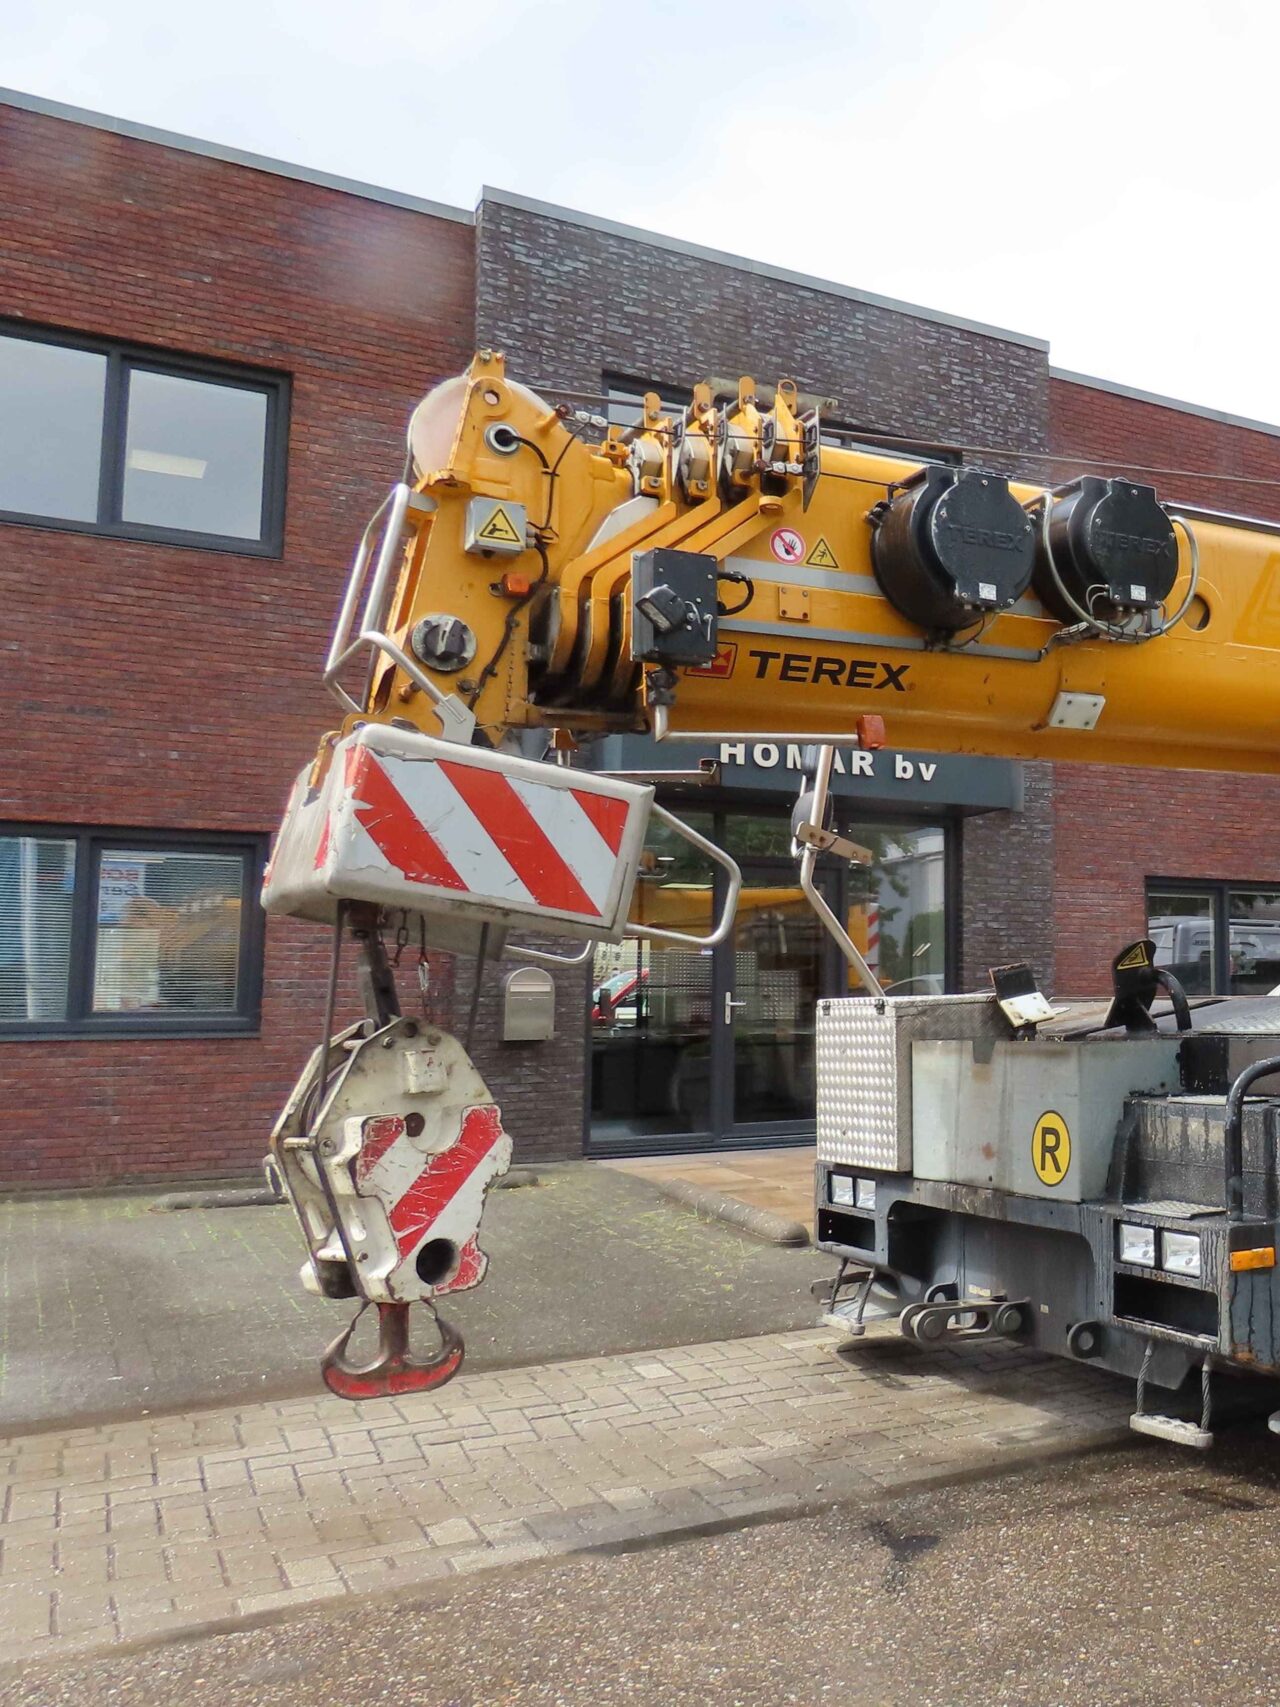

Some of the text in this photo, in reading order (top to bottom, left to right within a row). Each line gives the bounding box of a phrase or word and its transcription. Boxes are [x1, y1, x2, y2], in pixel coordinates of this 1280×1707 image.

[948, 524, 1023, 552] TEREX
[749, 650, 910, 692] TEREX
[895, 754, 937, 781] bv
[1041, 1127, 1062, 1173] R
